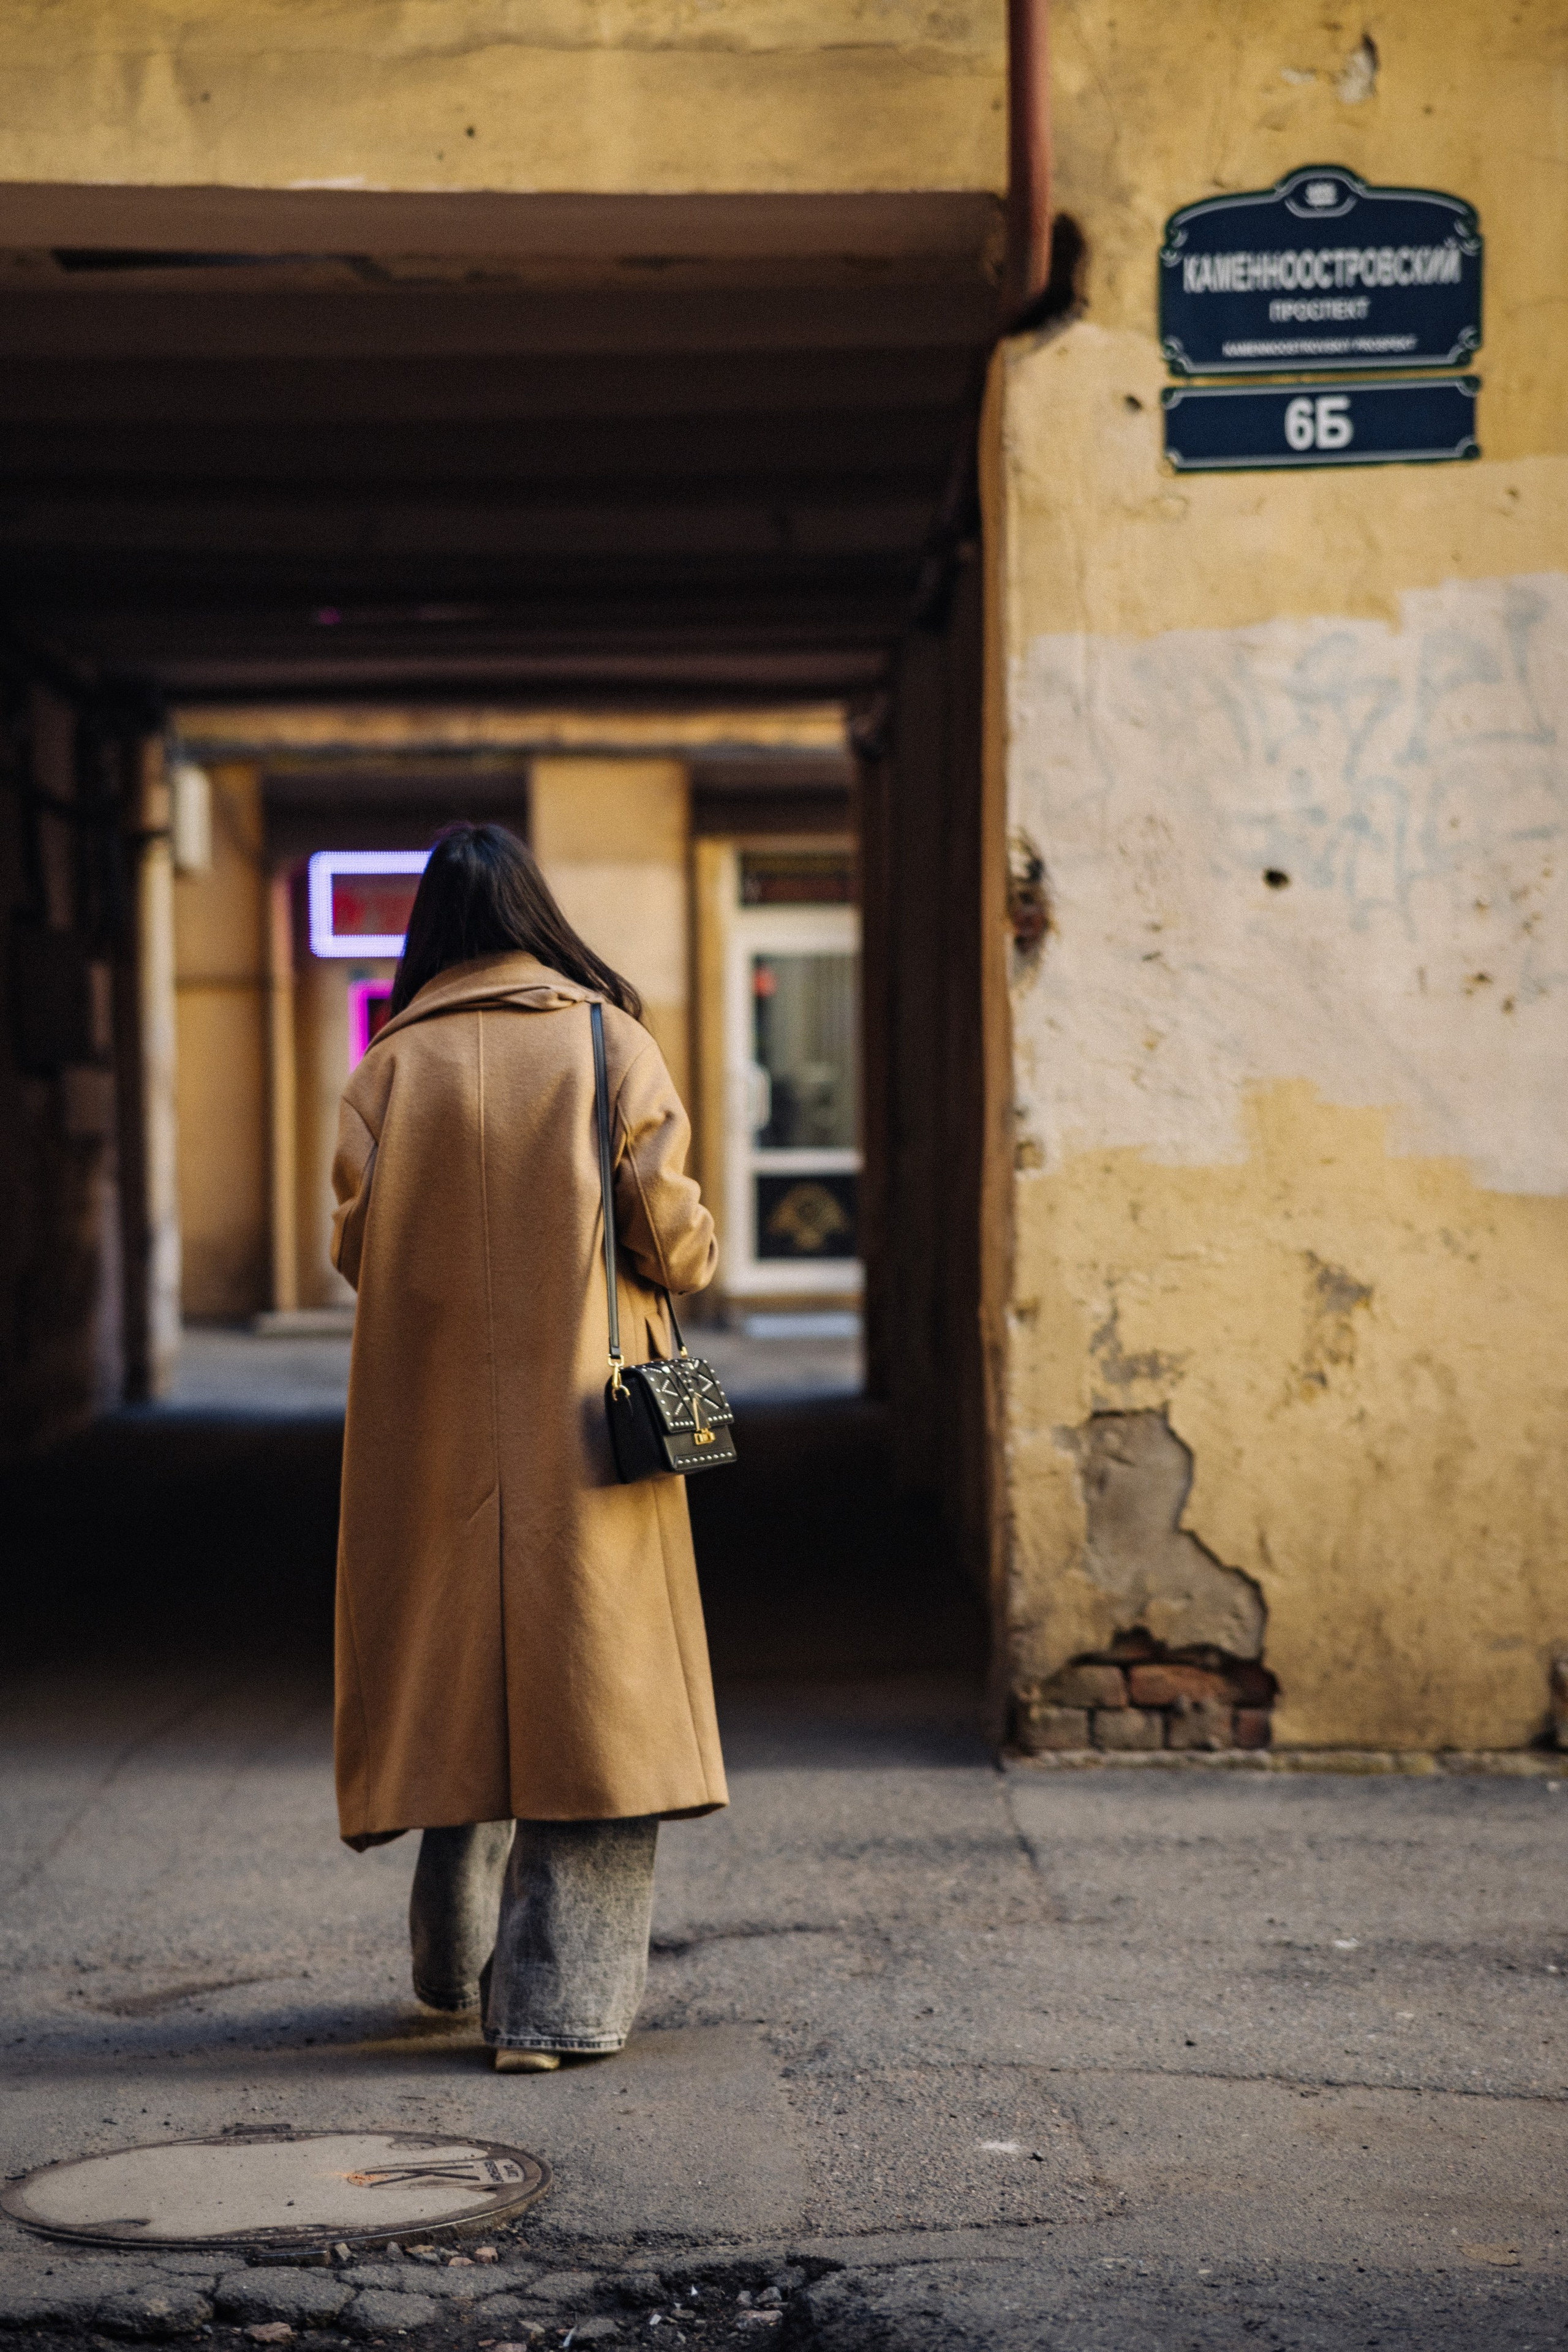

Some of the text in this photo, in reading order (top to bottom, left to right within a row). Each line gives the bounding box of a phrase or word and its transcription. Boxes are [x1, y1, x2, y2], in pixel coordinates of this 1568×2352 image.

[1183, 239, 1461, 293] КАМЕННООСТРОВСКИЙ
[1269, 297, 1370, 322] ПРОСПЕКТ
[1284, 396, 1353, 451] 6Б
